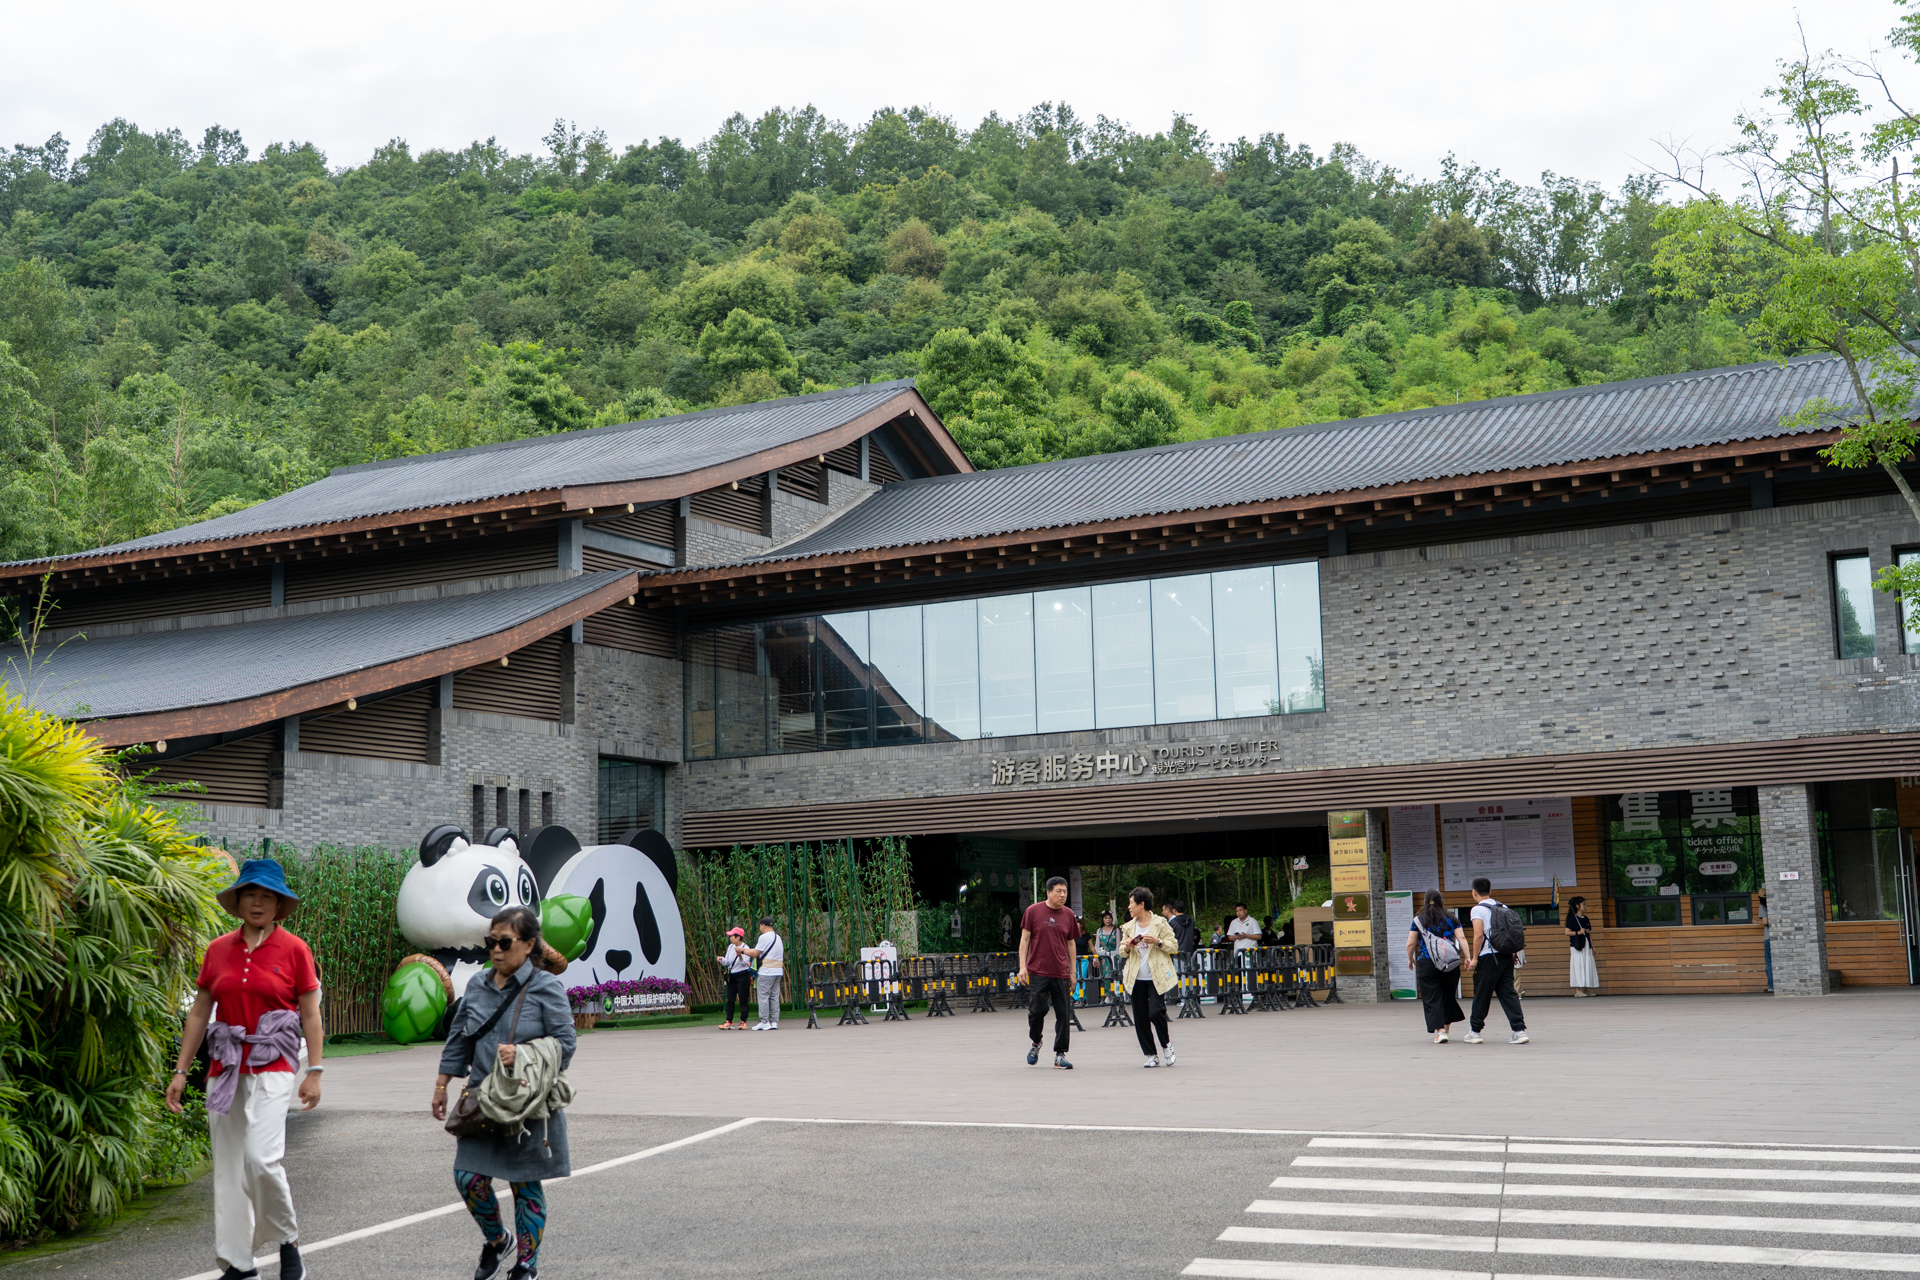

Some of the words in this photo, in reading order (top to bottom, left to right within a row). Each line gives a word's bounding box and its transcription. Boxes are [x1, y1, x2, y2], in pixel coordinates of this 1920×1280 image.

[1152, 746, 1214, 759] TOURIST
[1219, 740, 1279, 754] CENTER
[991, 748, 1149, 786] 游客服务中心
[1151, 755, 1281, 774] 観光客サービスセンター
[1478, 806, 1504, 814] 价目表
[1617, 787, 1739, 833] 售票
[1687, 838, 1712, 846] ticket
[1716, 836, 1744, 846] office
[1694, 846, 1740, 854] チケット売り場
[614, 992, 684, 1006] 中国大熊猫保护研究中心
